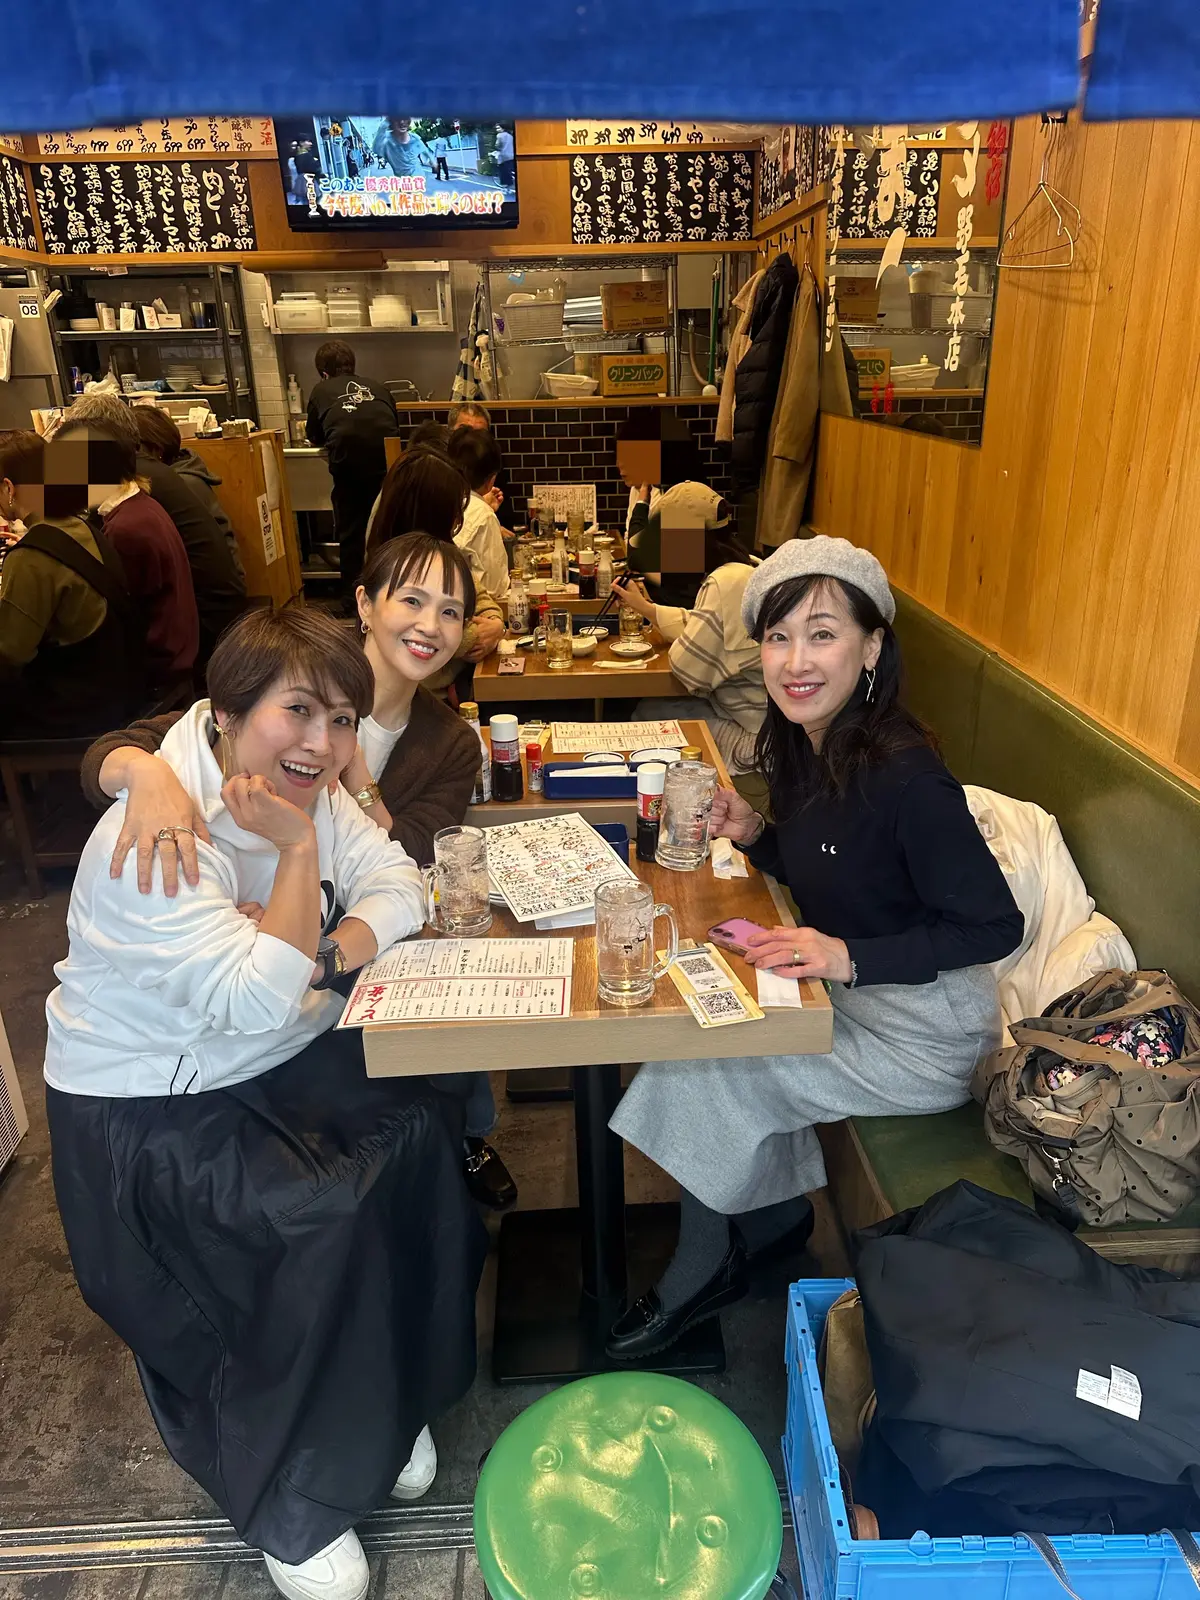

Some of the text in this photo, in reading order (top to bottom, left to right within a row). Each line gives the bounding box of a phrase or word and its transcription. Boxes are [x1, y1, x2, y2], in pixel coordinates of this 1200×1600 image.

[570, 128, 588, 145] 399
[617, 127, 636, 145] 399
[639, 122, 658, 140] 399
[661, 127, 681, 144] 499
[44, 142, 60, 154] 599
[90, 139, 110, 153] 799
[116, 139, 134, 152] 699
[141, 142, 158, 153] 699
[164, 141, 183, 153] 699
[187, 138, 206, 151] 699
[320, 177, 426, 193] このあと優秀作品賞
[686, 154, 708, 241] 冷やっこ 299
[154, 164, 180, 245] 冷やしトマト
[573, 233, 594, 244] 499
[642, 230, 662, 243] 499
[665, 231, 684, 243] 299
[711, 230, 729, 242] 299
[731, 229, 752, 241] 299
[48, 241, 66, 255] 399
[72, 240, 90, 254] 499
[187, 241, 208, 253] 499
[232, 237, 254, 250] 399
[944, 203, 974, 373] 野毛本店
[21, 304, 39, 316] 08
